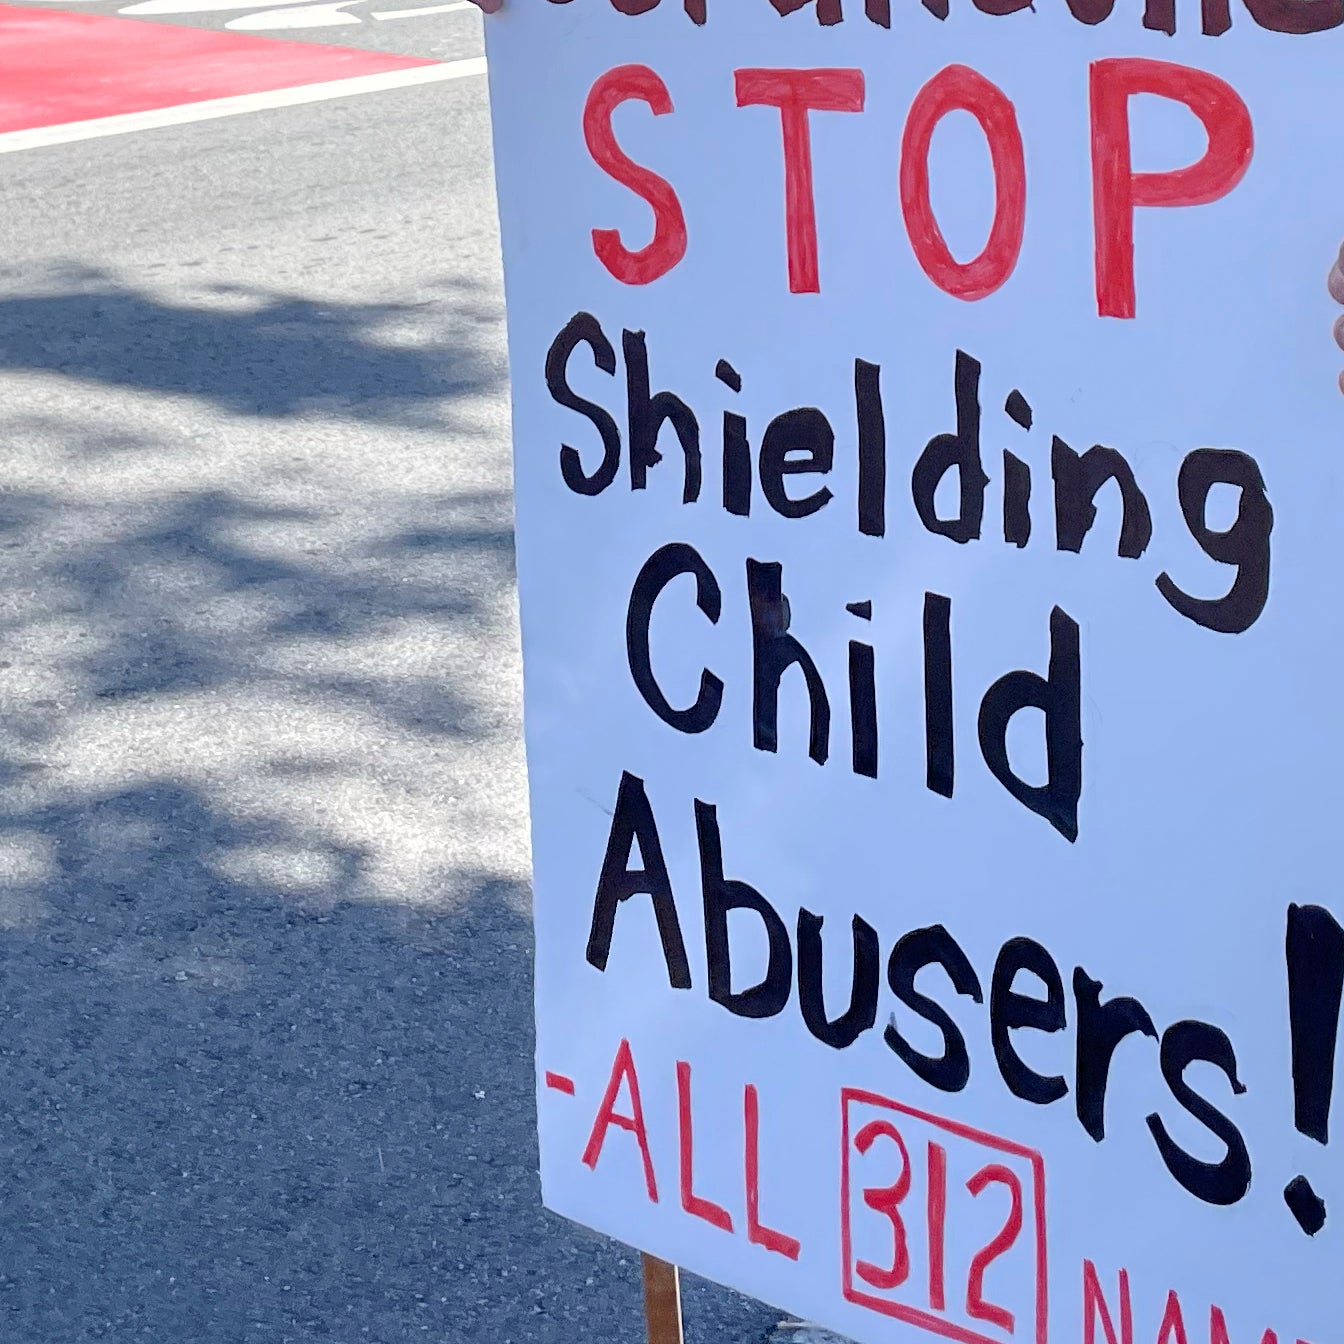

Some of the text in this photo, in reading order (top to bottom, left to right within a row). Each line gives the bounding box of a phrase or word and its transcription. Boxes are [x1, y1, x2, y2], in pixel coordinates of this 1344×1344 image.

[581, 57, 1254, 320] STOP
[544, 311, 1275, 635] Shielding
[625, 542, 1085, 844] Child
[853, 1120, 1024, 1334] 312
